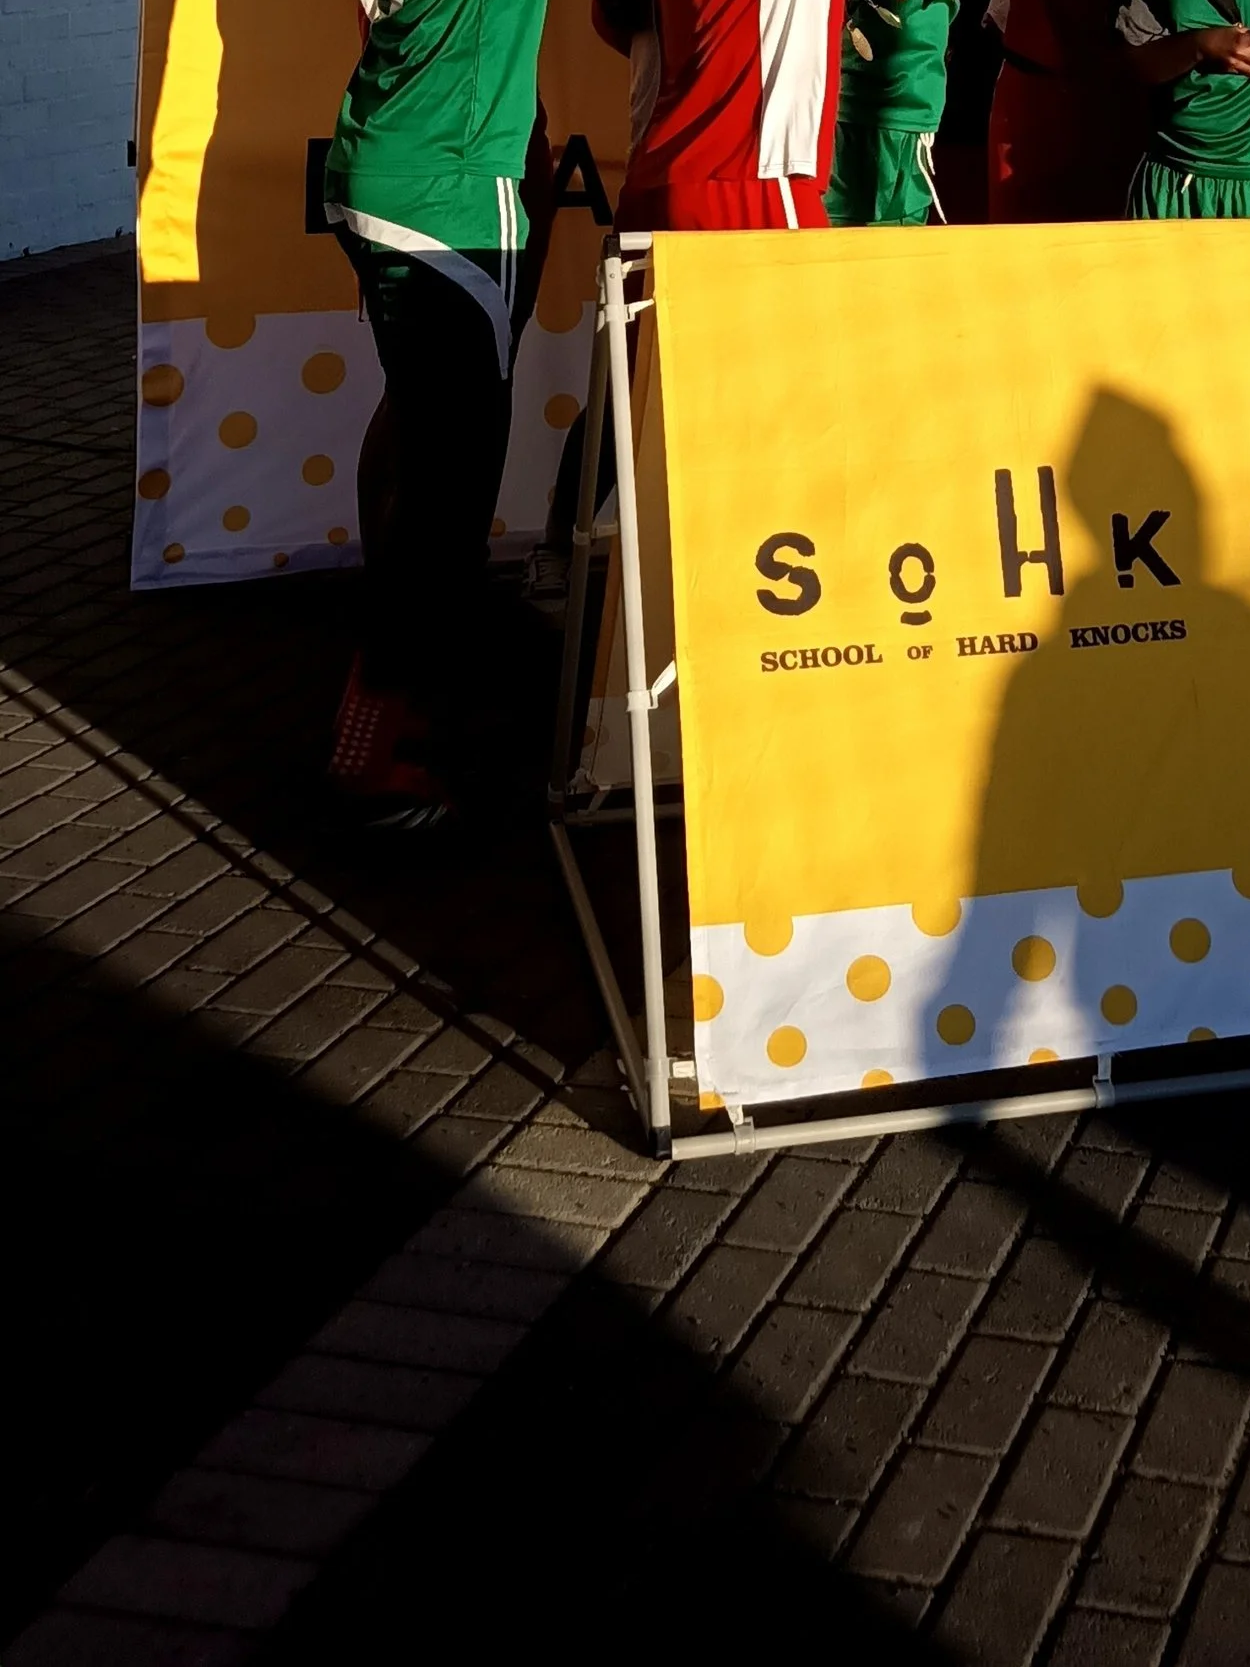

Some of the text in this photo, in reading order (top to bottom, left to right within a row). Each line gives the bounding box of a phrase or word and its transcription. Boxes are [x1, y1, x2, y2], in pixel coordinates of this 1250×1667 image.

[760, 619, 1188, 673] SCHOOL OF HARD KNOCKS
